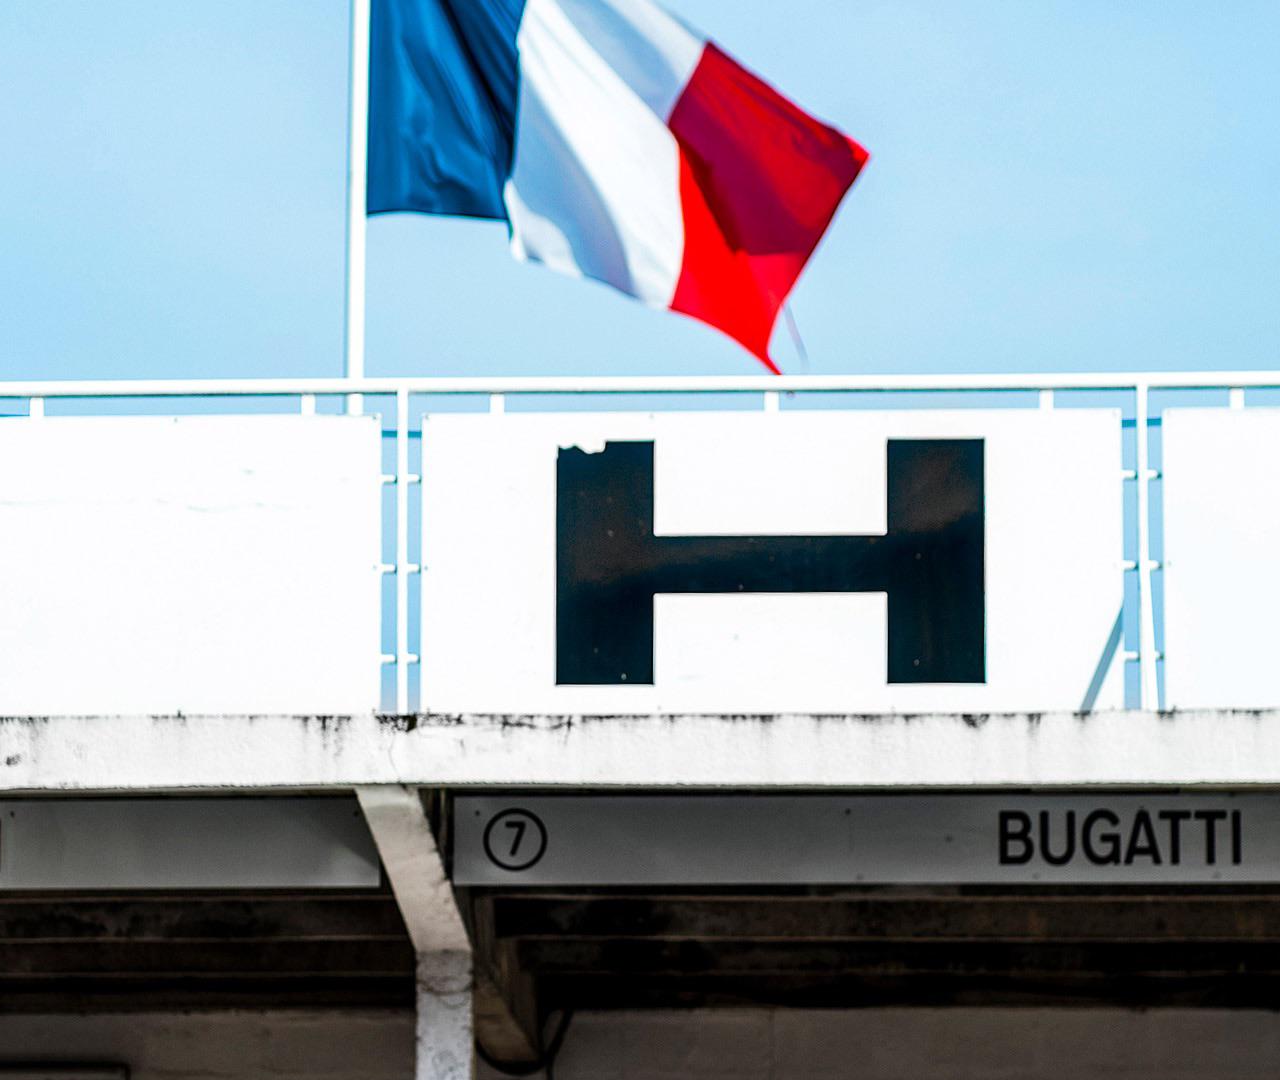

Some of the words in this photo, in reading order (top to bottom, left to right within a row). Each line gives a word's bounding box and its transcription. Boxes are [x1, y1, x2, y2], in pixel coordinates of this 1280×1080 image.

[555, 438, 987, 686] H
[504, 820, 528, 857] 7
[997, 808, 1243, 867] BUGATTI
